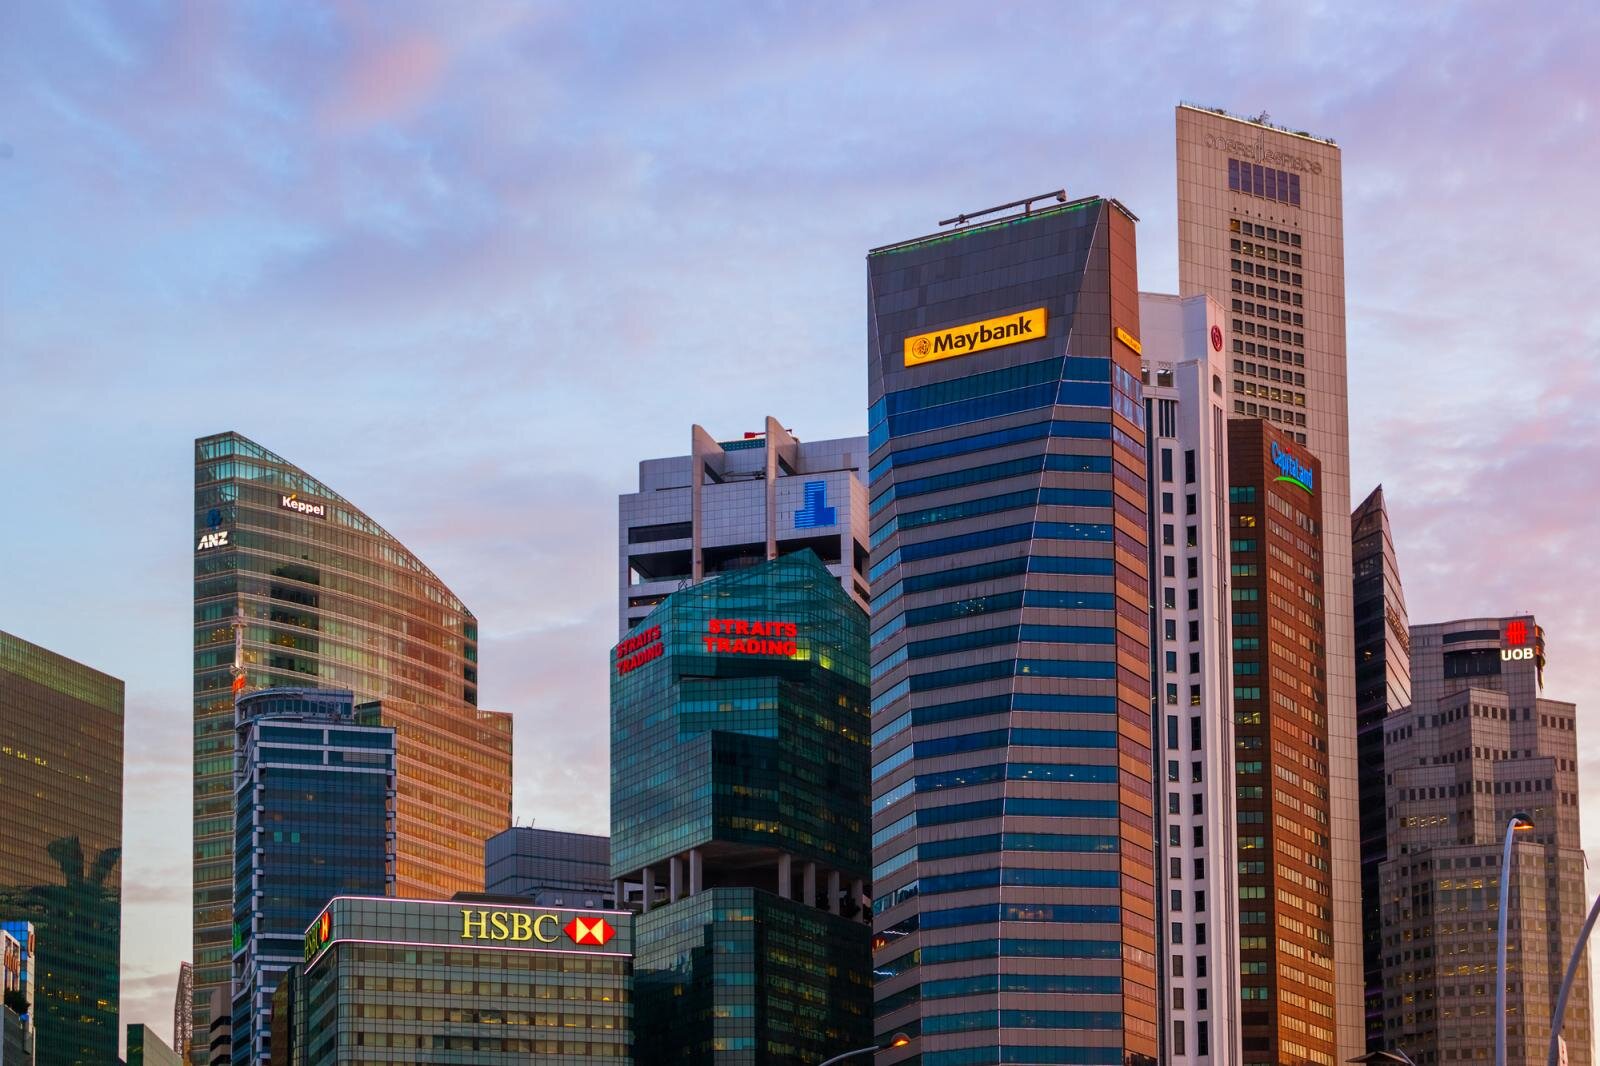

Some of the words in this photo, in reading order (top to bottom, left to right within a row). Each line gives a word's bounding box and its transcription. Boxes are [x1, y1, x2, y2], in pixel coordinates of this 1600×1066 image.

[933, 316, 1032, 353] Maybank
[282, 495, 324, 516] Keppel
[197, 530, 229, 550] ANZ
[708, 618, 798, 638] STRAITS
[616, 624, 662, 659] STRAITS
[703, 636, 798, 657] TRADING
[615, 641, 665, 677] TRADING
[1501, 647, 1534, 661] UOB
[461, 909, 559, 943] HSBC
